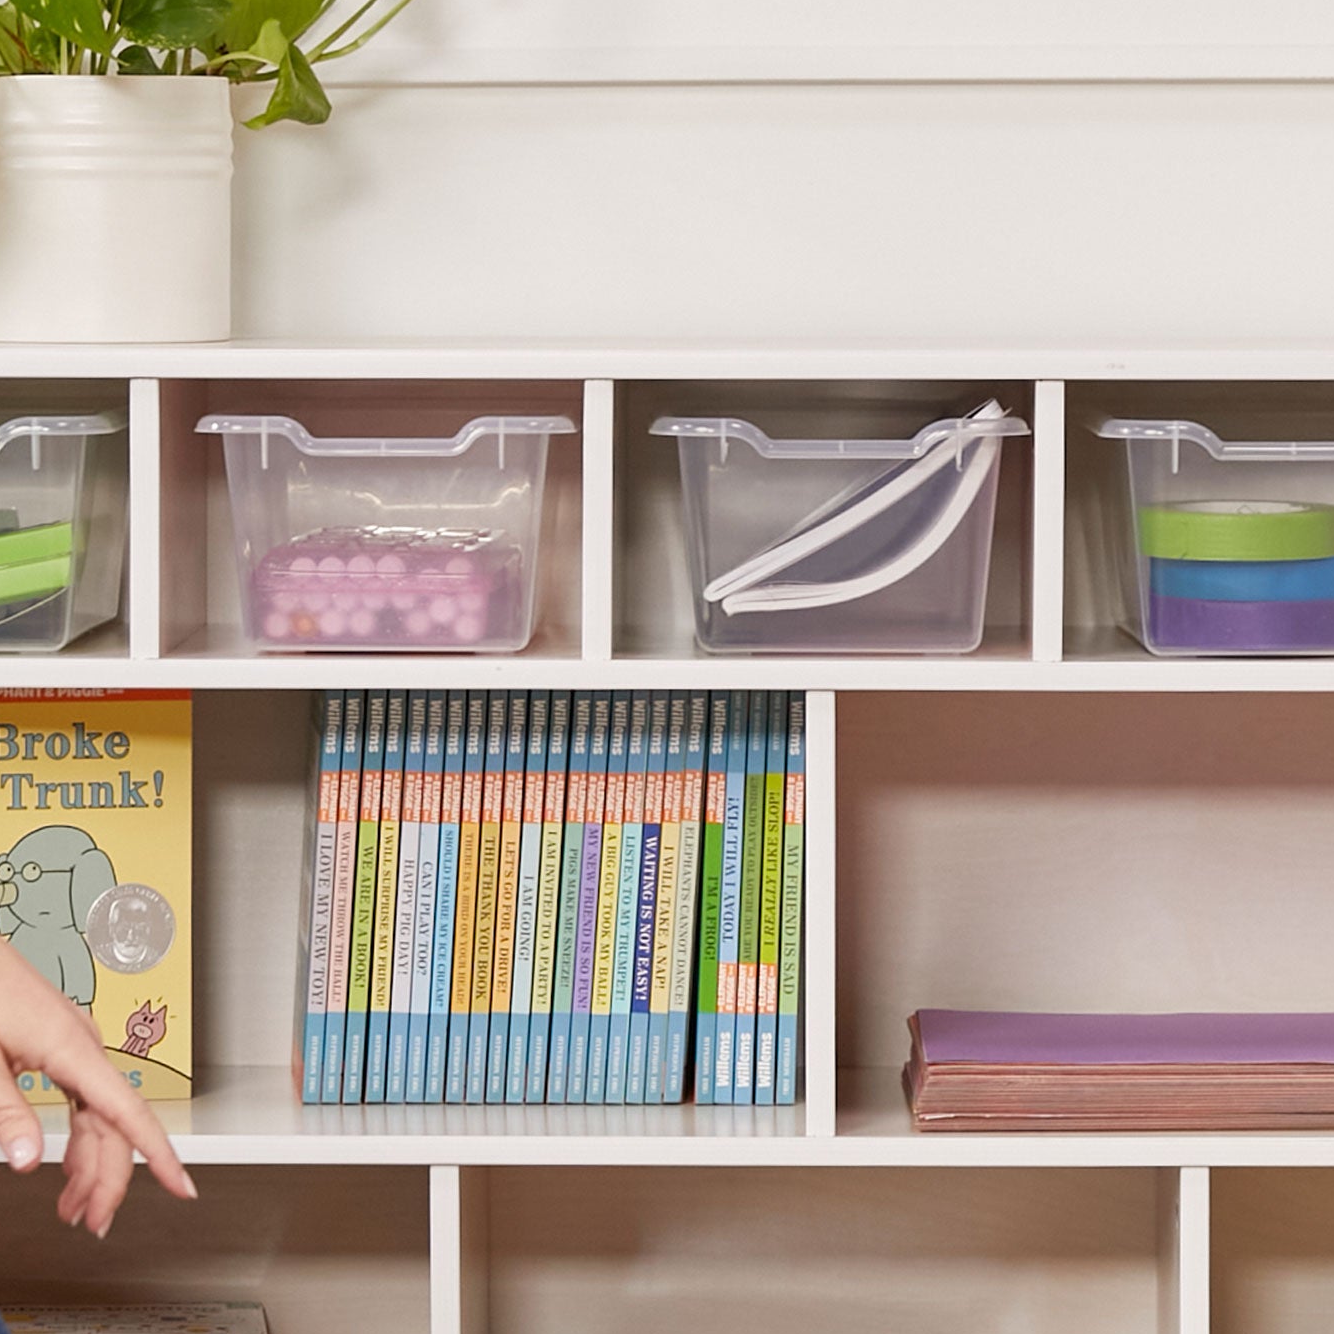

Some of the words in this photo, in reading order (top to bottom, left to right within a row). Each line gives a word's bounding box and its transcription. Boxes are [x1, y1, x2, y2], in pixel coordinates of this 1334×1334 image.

[57, 688, 104, 698] PIGGIE
[325, 698, 341, 753] Willems
[488, 699, 504, 754] Willems
[591, 699, 608, 754] Willems
[688, 697, 704, 752] Willems
[789, 700, 802, 755] Willems
[0, 770, 164, 811] Trunk!
[727, 797, 739, 830] FLY!
[767, 791, 780, 833] SLOP!
[382, 834, 394, 866] WILL
[483, 836, 495, 867] THE
[545, 840, 557, 859] AM
[587, 828, 599, 848] MY
[607, 832, 617, 841] A
[317, 845, 332, 888] LOVE
[361, 845, 373, 870] WE
[503, 841, 515, 878] LET'S
[567, 848, 578, 875] PIGS
[585, 851, 597, 883] NEW
[605, 845, 617, 868] BIG
[622, 835, 635, 883] LISTEN
[641, 836, 657, 901] WAITING
[680, 826, 695, 901] ELEPHANTS
[725, 835, 738, 876] WILL
[765, 836, 778, 872] LIKE
[786, 845, 799, 868] MY
[359, 874, 372, 904] ARE
[401, 859, 415, 907] HAPPY
[421, 861, 433, 889] CAN
[502, 881, 513, 901] GO
[541, 863, 555, 918] INVITED
[603, 871, 615, 898] GUY
[660, 856, 673, 893] WILL
[706, 876, 718, 897] I'M
[316, 893, 329, 917] MY
[379, 869, 392, 930] SURPRISE
[479, 871, 493, 921] THANK
[521, 884, 533, 906] AM
[564, 878, 576, 913] MAKE
[581, 887, 595, 937] FRIEND
[621, 887, 632, 905] TO
[640, 905, 652, 919] IS
[705, 901, 717, 911] A
[763, 874, 777, 937] REALLY
[784, 874, 798, 937] FRIEND
[356, 928, 368, 938] A
[357, 909, 369, 924] IN
[399, 912, 411, 936] PIG
[418, 902, 431, 937] PLAY
[500, 903, 512, 931] FOR
[540, 921, 551, 939] TO
[563, 916, 573, 934] ME
[600, 902, 613, 938] TOOK
[619, 909, 631, 928] MY
[657, 897, 671, 937] TAKE
[676, 904, 689, 955] CANNOT
[722, 891, 735, 943] TODAY
[313, 923, 327, 962] NEW
[377, 934, 388, 952] MY
[477, 926, 490, 955] YOU
[499, 934, 509, 943] A
[518, 910, 532, 961] GOING!
[539, 943, 549, 951] A
[579, 940, 591, 953] IS
[637, 922, 651, 954] NOT
[656, 941, 667, 950] A
[704, 915, 717, 961] FROG!
[783, 942, 796, 957] IS
[353, 942, 367, 988] BOOK!
[397, 941, 409, 975] DAY!
[416, 940, 429, 976] TOO?
[496, 947, 509, 993] DRIVE!
[559, 937, 572, 987] SNEEZE!
[579, 957, 590, 975] SO
[599, 943, 610, 963] MY
[615, 931, 629, 1001] TRUMPET!
[311, 966, 325, 1005] TOY!
[375, 956, 387, 1006] FRIEND!
[475, 959, 488, 1000] BOOK
[536, 956, 549, 1005] PARTY!
[595, 966, 608, 1005] BALL!
[634, 957, 649, 1000] EASY!
[654, 955, 667, 989] NAP!
[673, 959, 686, 1005] DANCE!
[782, 961, 795, 995] SAD
[576, 978, 589, 1009] FUN!
